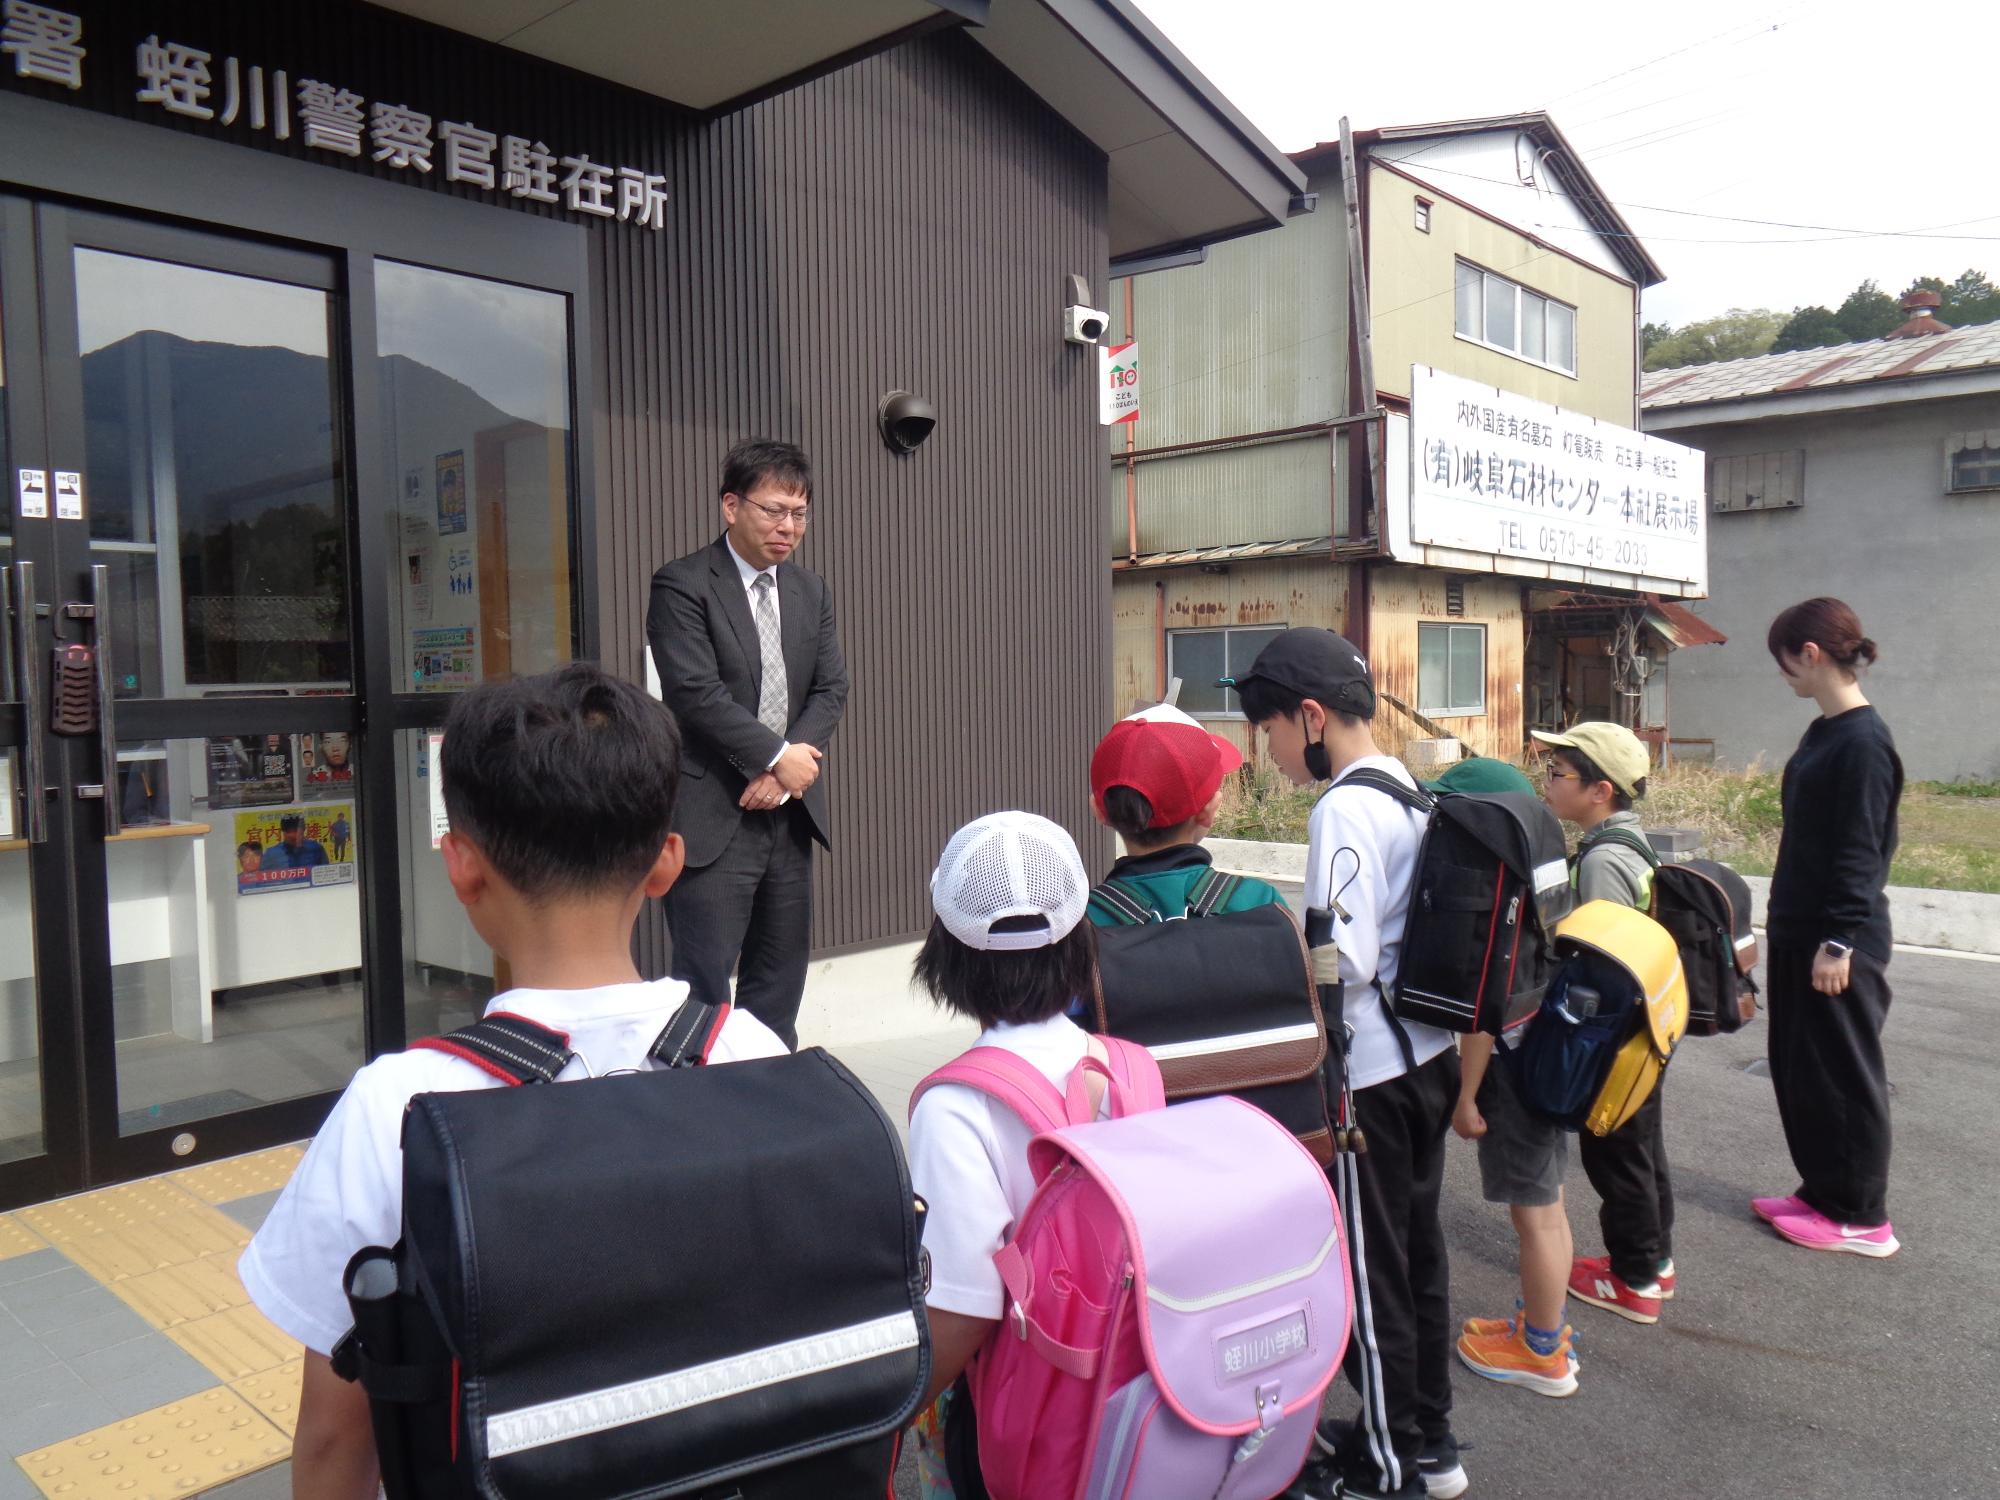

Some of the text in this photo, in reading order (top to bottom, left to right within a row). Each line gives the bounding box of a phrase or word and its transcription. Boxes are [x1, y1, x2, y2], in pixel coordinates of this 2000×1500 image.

[0, 0, 669, 231] 署 蛭川警察官駐在所
[1115, 392, 1132, 400] こども
[1457, 400, 1552, 448] 内外国産有名墓石
[1499, 520, 1648, 566] TEL 0573-45-2033
[262, 868, 306, 881] 100万円
[1595, 1279, 1618, 1299] N
[1223, 1321, 1308, 1374] 蛭川小学校
